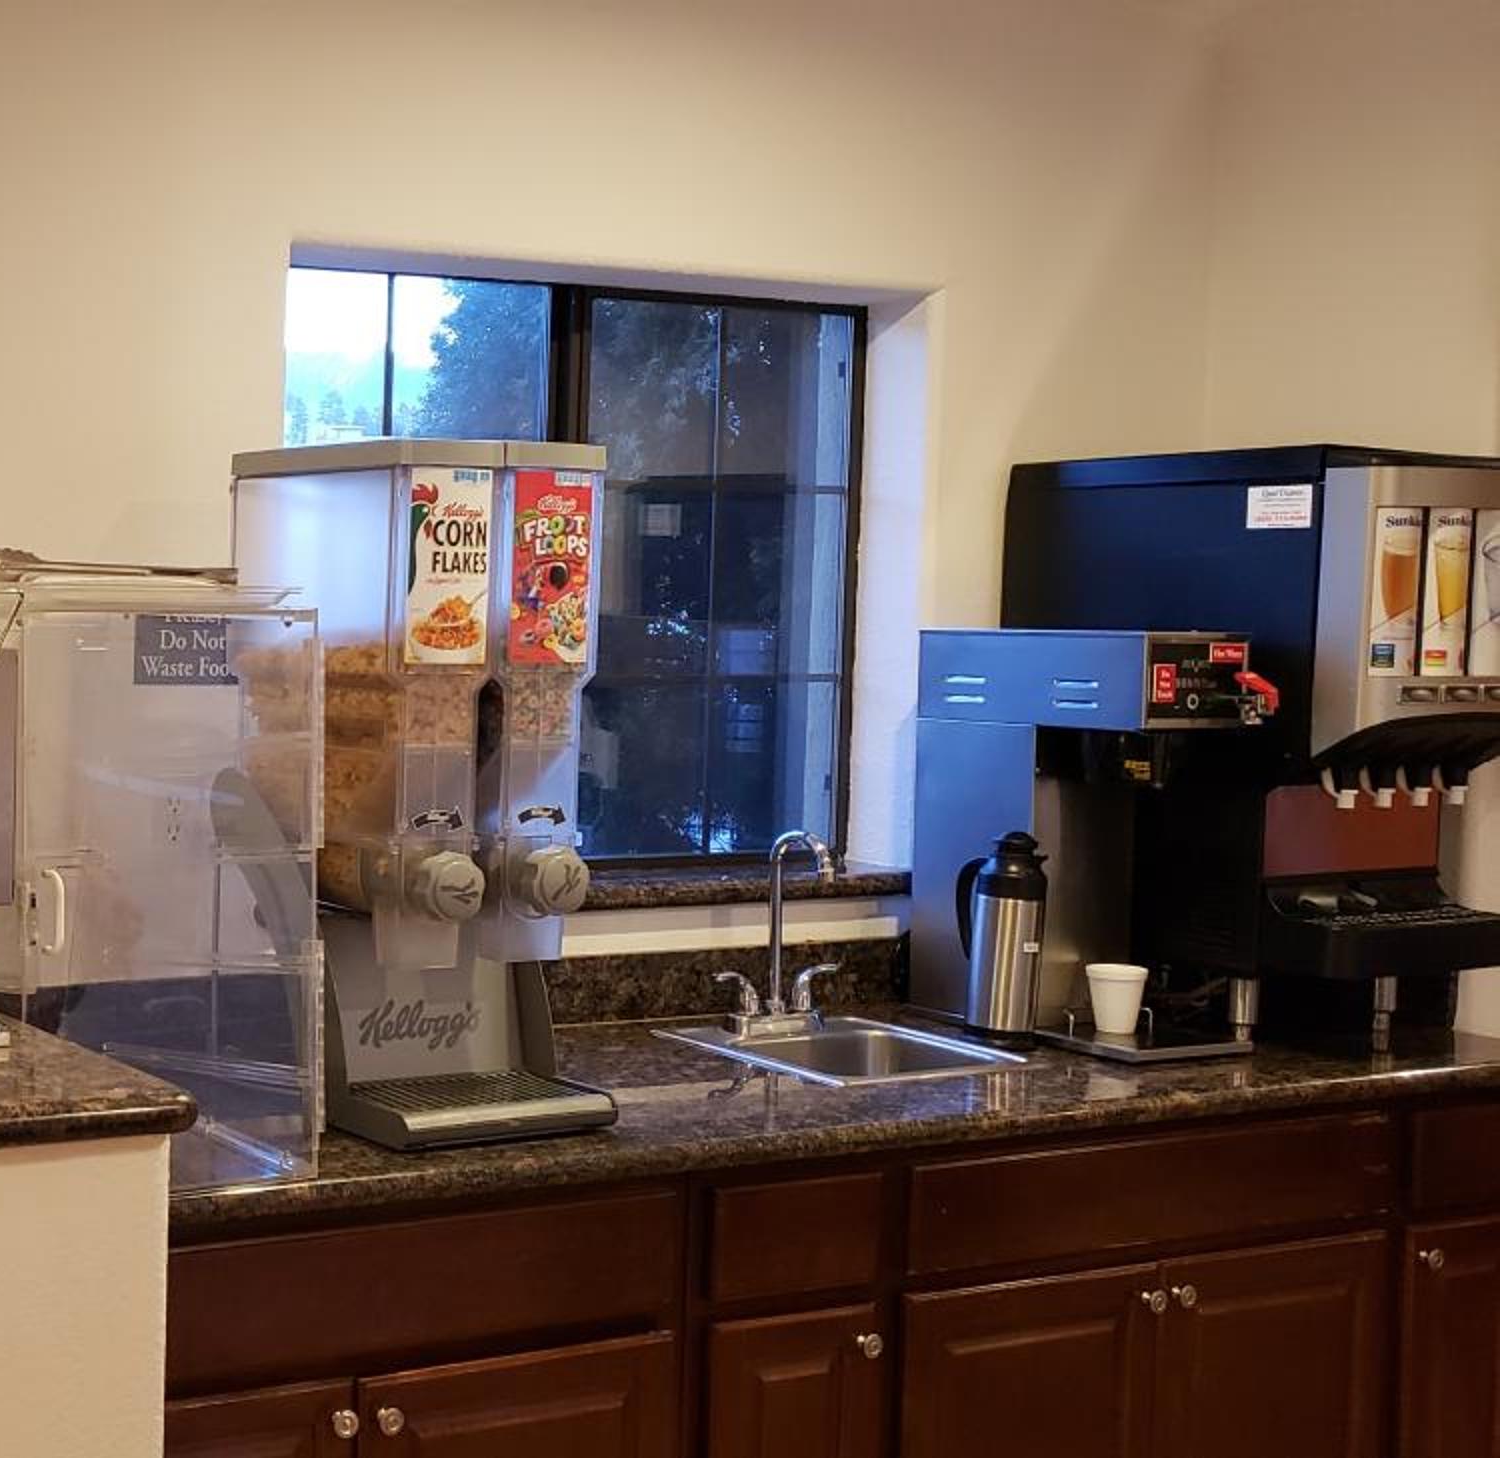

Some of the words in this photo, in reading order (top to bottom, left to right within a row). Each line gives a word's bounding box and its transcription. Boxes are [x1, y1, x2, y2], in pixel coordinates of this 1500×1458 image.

[432, 519, 488, 547] CORN
[534, 535, 589, 557] LOOPS
[431, 551, 488, 575] FLAKES
[159, 629, 187, 651] Do
[191, 629, 226, 651] Not
[141, 655, 194, 677] Waste
[199, 655, 229, 677] Foo
[357, 999, 482, 1051] Kellogg's
